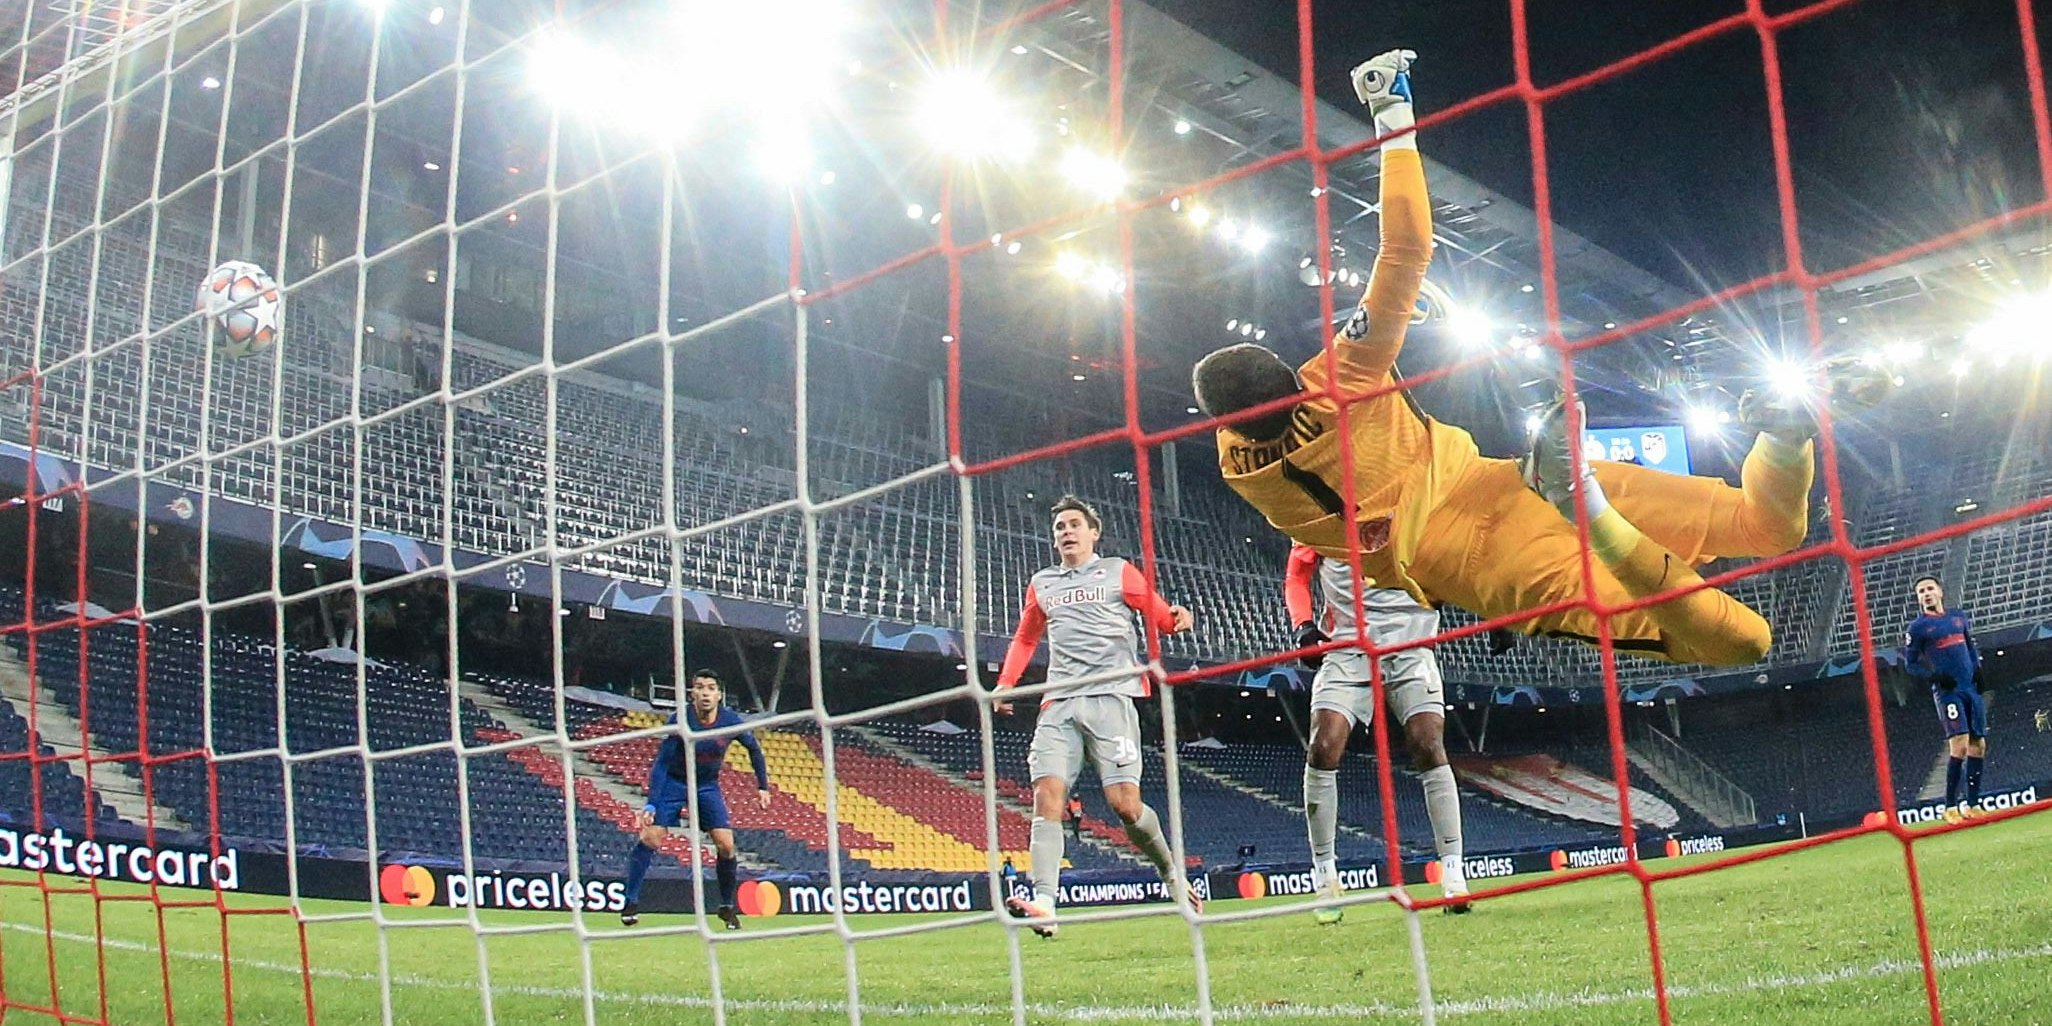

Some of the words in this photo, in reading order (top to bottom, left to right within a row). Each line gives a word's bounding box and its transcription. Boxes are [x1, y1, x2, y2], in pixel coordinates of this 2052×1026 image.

[1946, 703, 1959, 720] 8
[1111, 735, 1138, 760] 39
[1897, 785, 2037, 825] mascard
[1680, 834, 1724, 855] priceless
[1269, 864, 1379, 895] mastcard
[1461, 856, 1514, 879] iceless
[446, 869, 627, 911] priceless
[789, 880, 972, 913] mastercard
[1070, 883, 1145, 903] CHAMPIONS
